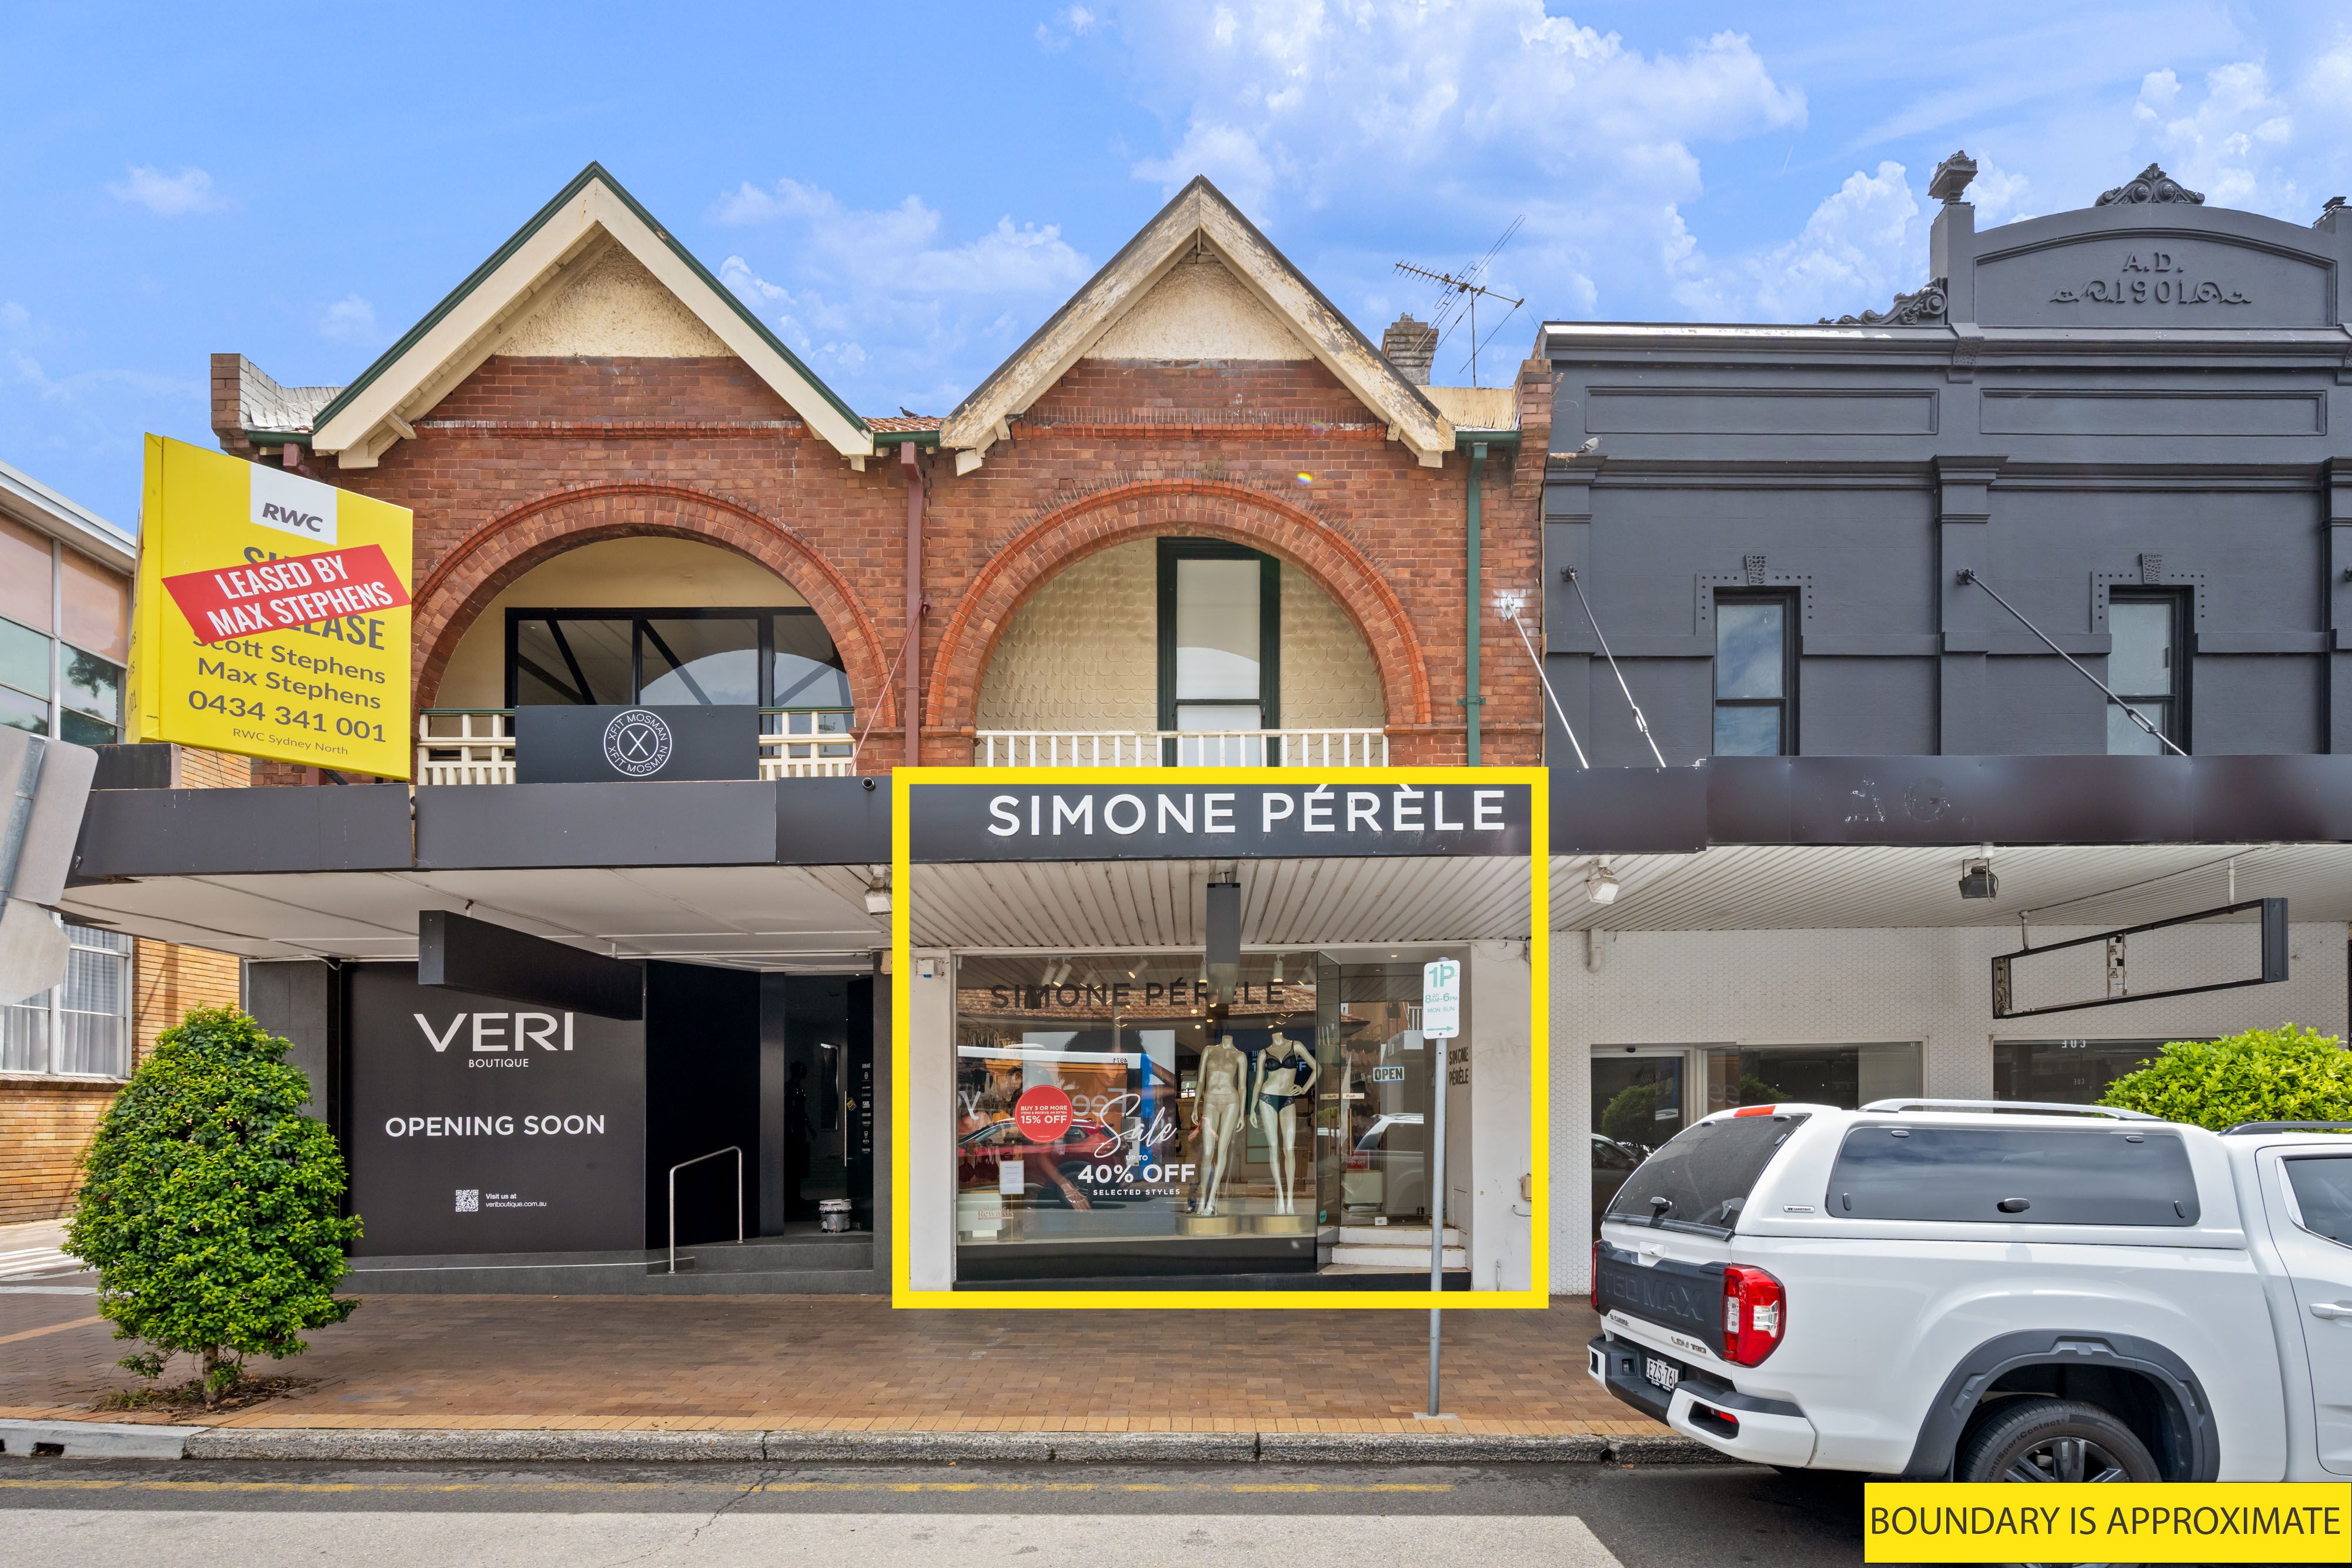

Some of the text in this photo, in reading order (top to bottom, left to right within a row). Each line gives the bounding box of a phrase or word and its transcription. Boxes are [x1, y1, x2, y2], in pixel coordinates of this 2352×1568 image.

[2116, 278, 2188, 304] 1901
[262, 502, 323, 533] RWC
[213, 561, 312, 600] LEASED
[310, 554, 349, 583] BY
[206, 581, 393, 637] MAX STEPHENS
[270, 644, 386, 684] Stephens
[198, 657, 381, 710] Max Stephens
[188, 690, 386, 743] 0434 341 001
[607, 713, 668, 741] XFIT MOSMAN
[233, 728, 349, 755] RWC Sydney North
[607, 745, 669, 773] XFIT MOSMAN
[988, 784, 1505, 837] SIMONE PÉRÈLE
[1428, 965, 1455, 988] 1P
[990, 977, 1285, 1008] SIMONE PÉRLE
[413, 1012, 574, 1052] VERI
[468, 1058, 529, 1068] BOUTIQUE
[1449, 1046, 1469, 1065] SIMONE
[1374, 1067, 1404, 1081] OPEN
[1449, 1066, 1469, 1086] PÉRÈLE
[385, 1114, 605, 1137] OPENING SOON
[1020, 1115, 1068, 1124] 15% OFF
[1094, 1093, 1178, 1158] Sale
[1077, 1164, 1196, 1183] 40% OFF
[978, 1208, 1014, 1218] Rewards
[1642, 1276, 1705, 1322] MAX
